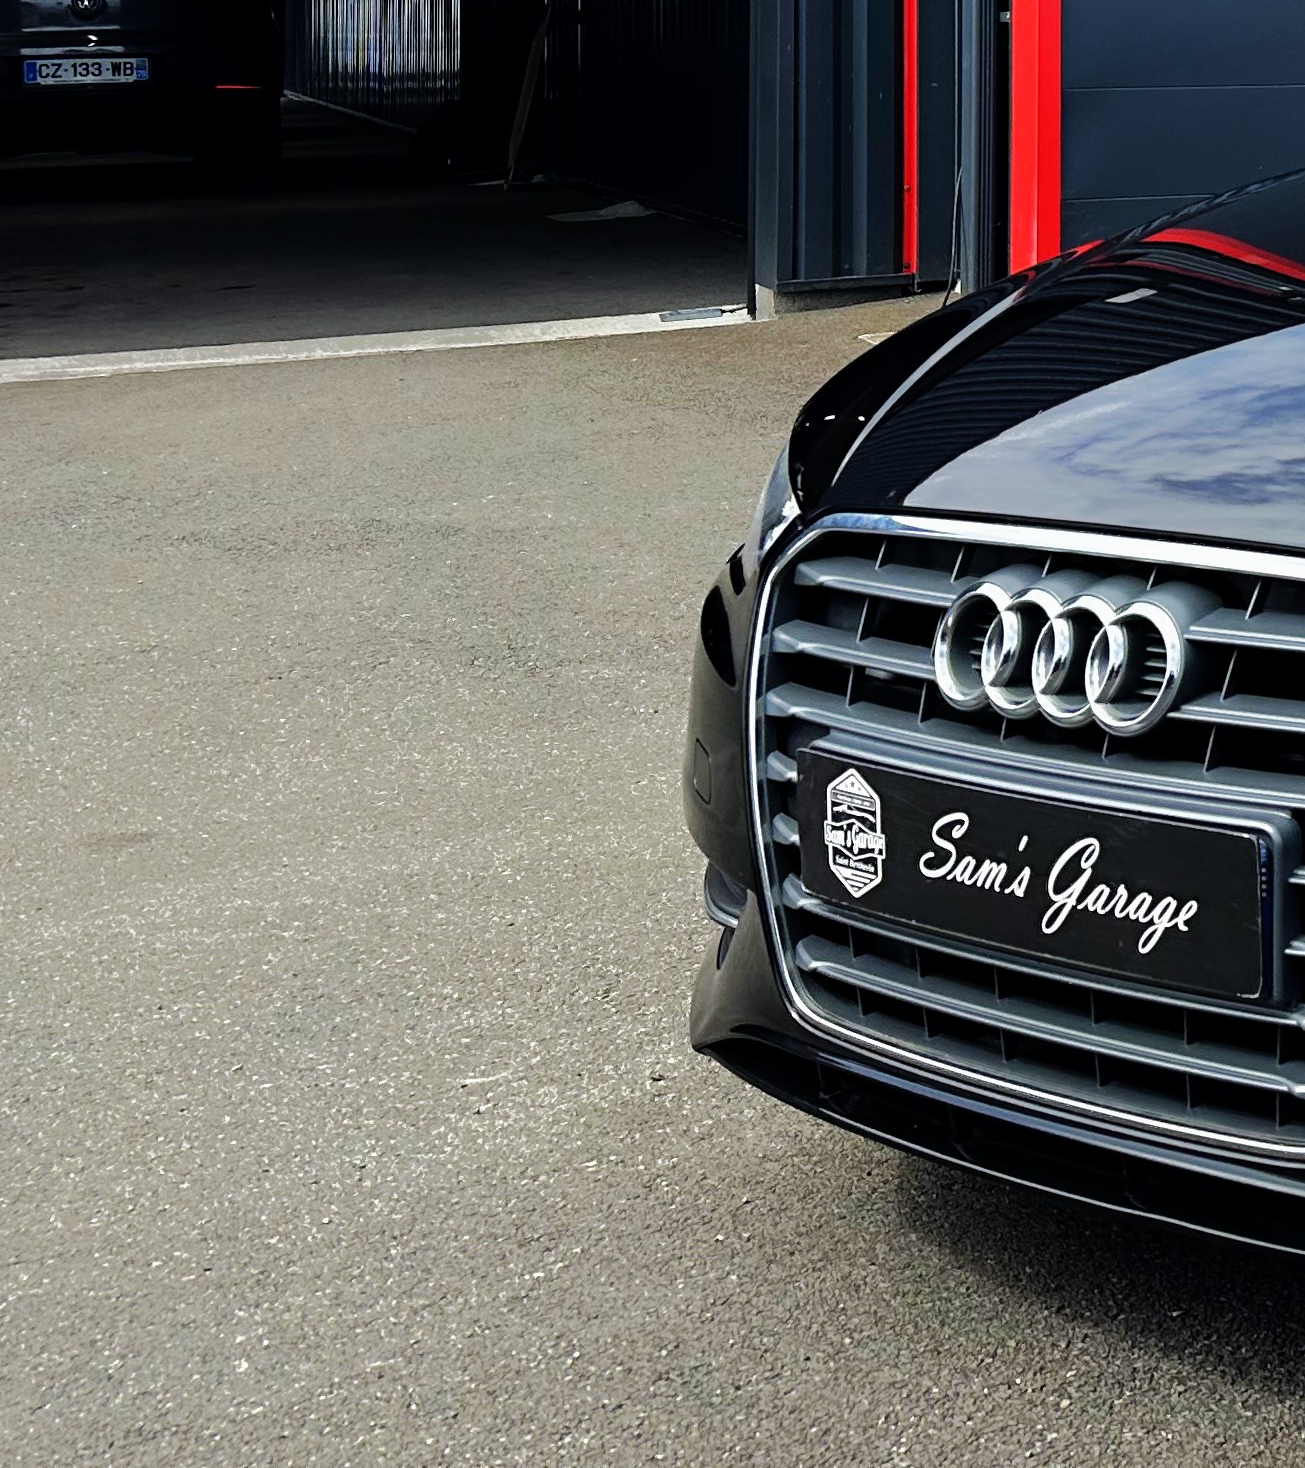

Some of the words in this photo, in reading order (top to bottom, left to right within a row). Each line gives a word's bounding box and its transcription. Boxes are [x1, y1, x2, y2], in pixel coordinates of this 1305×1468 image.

[38, 61, 135, 79] CZ-133-WB
[919, 812, 1032, 898] Sam's
[1041, 838, 1199, 955] Garage
